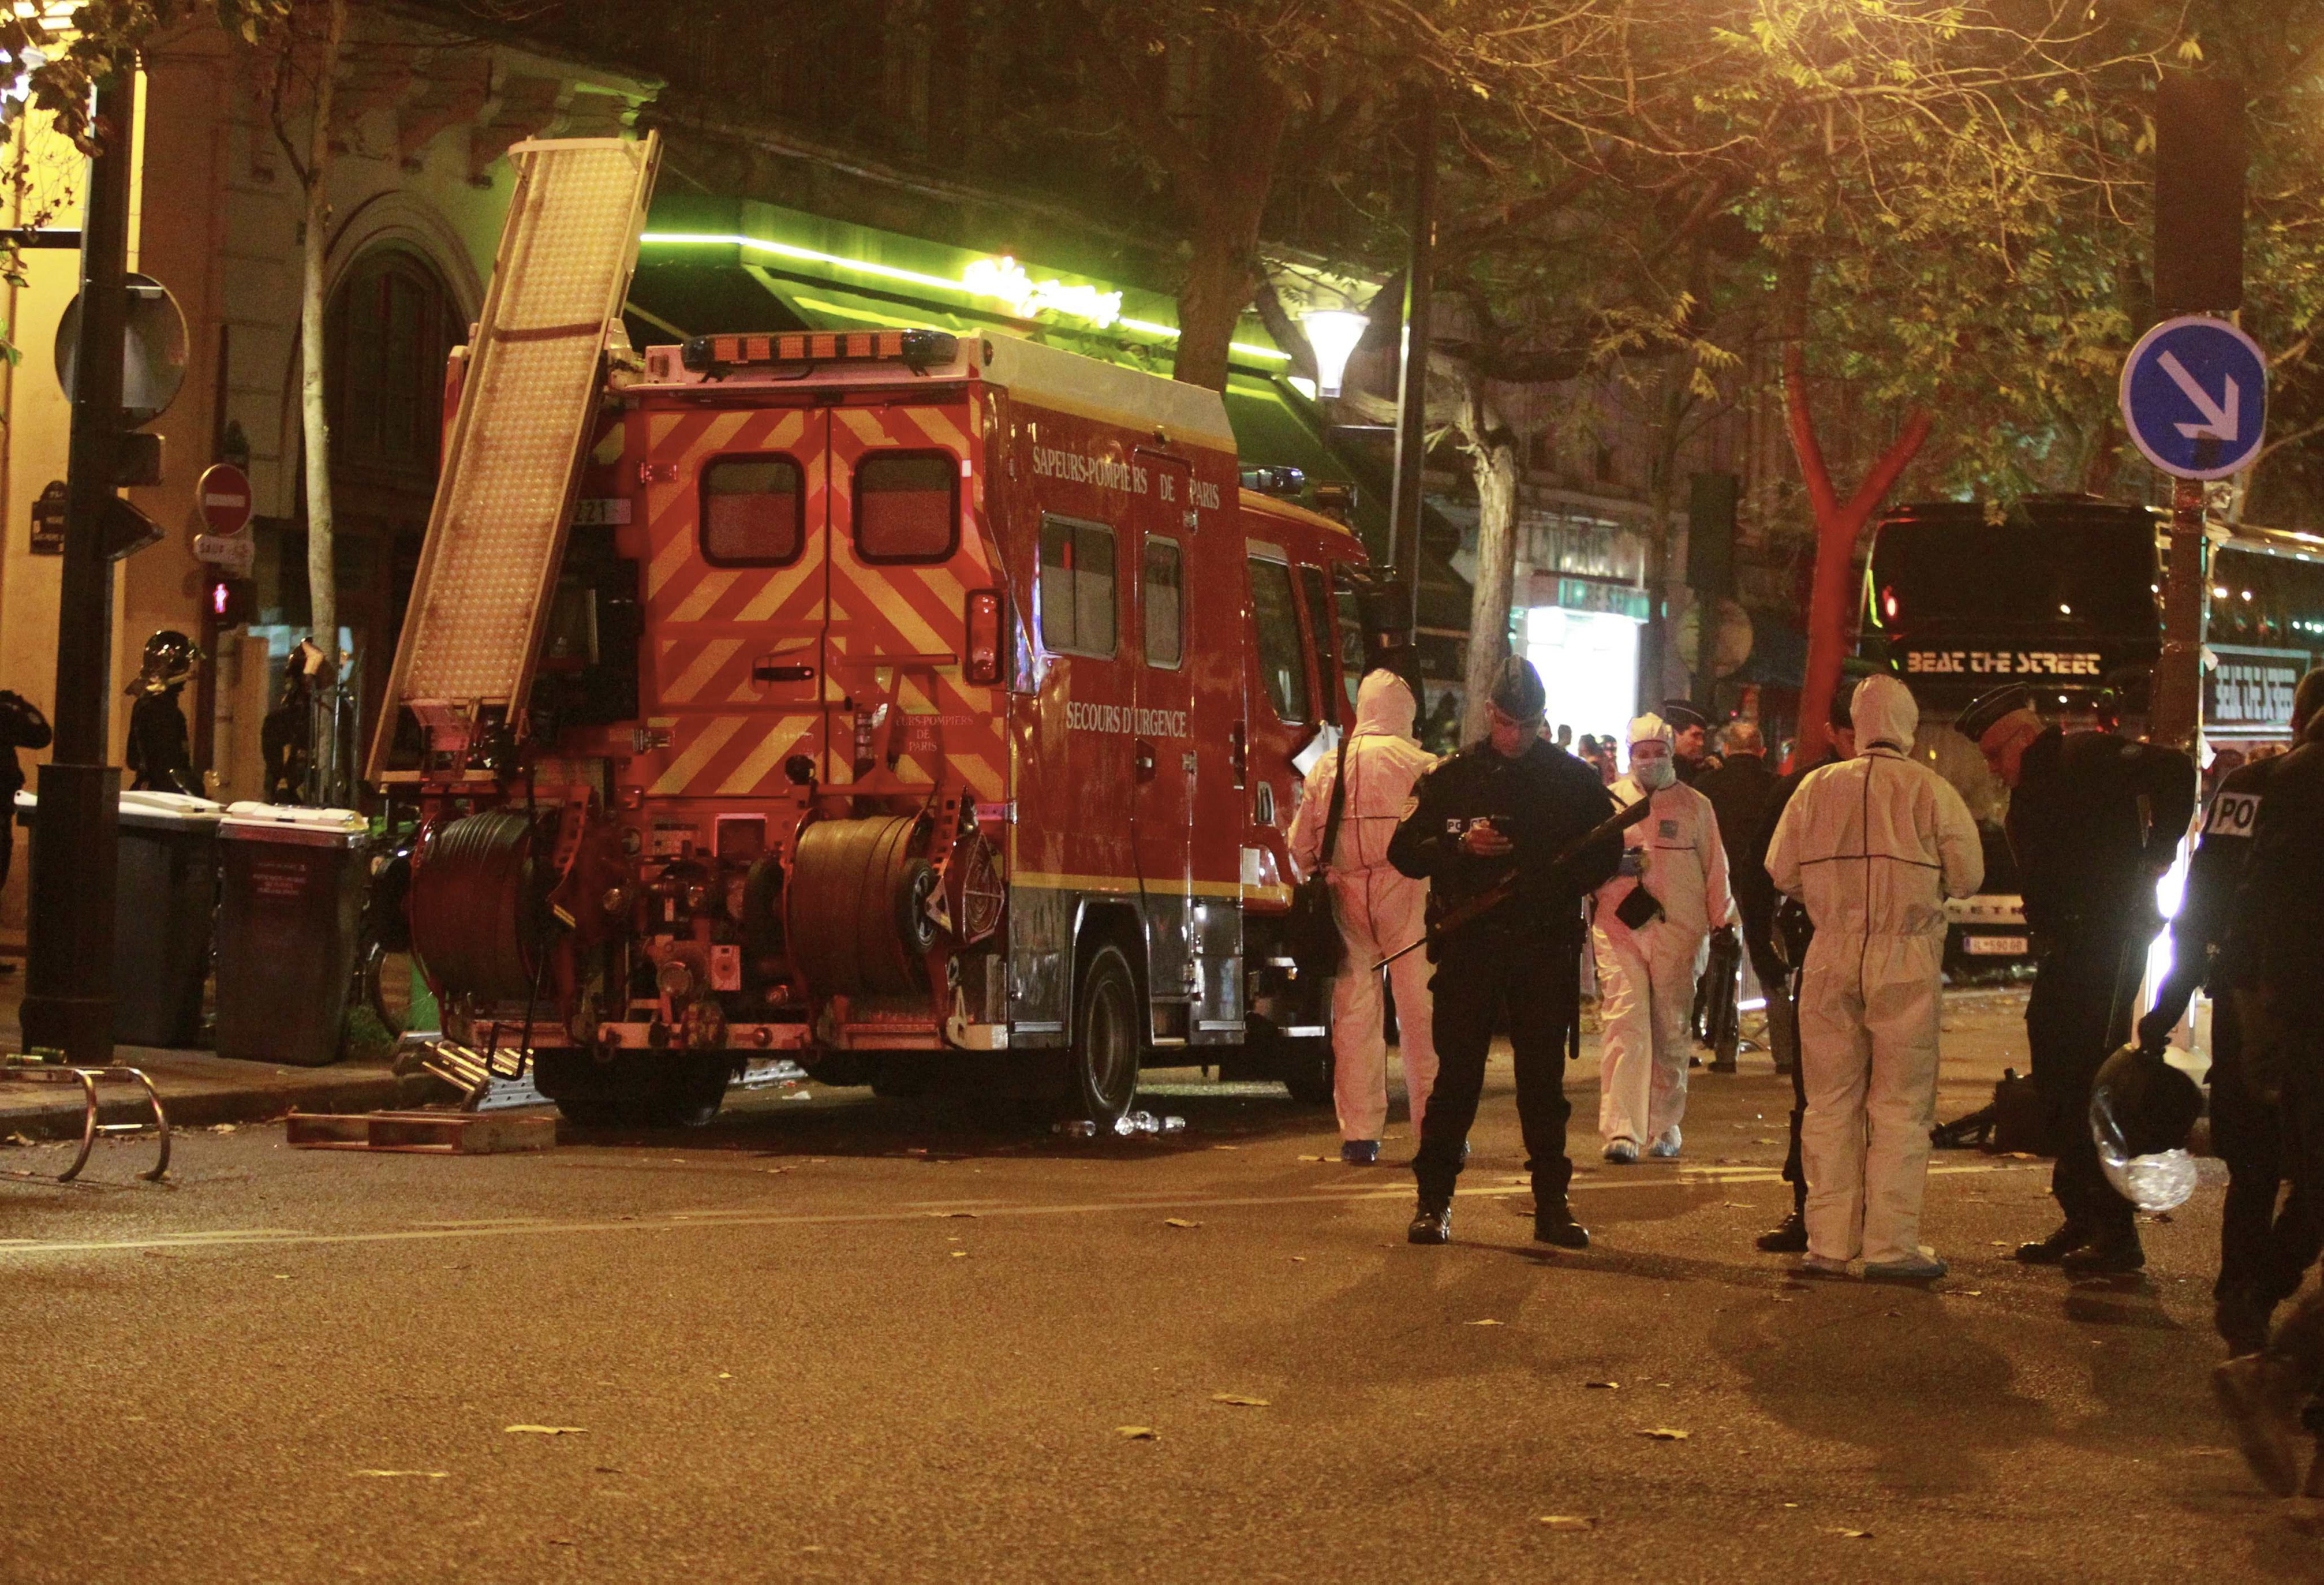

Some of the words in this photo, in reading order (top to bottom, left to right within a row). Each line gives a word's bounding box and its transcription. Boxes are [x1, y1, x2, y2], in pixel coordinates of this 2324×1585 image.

[1033, 446, 1148, 495] SAPEURS-POMPIERS
[1160, 474, 1175, 502] DE
[1189, 479, 1220, 510] PARIS
[1907, 651, 1965, 673] BEAT
[1970, 651, 2011, 673] THE
[2017, 652, 2101, 675] STREET
[1066, 701, 1121, 734] SECOURS
[1122, 706, 1187, 738] D'URGENCE
[917, 729, 931, 739] DE
[909, 741, 938, 752] PARIS
